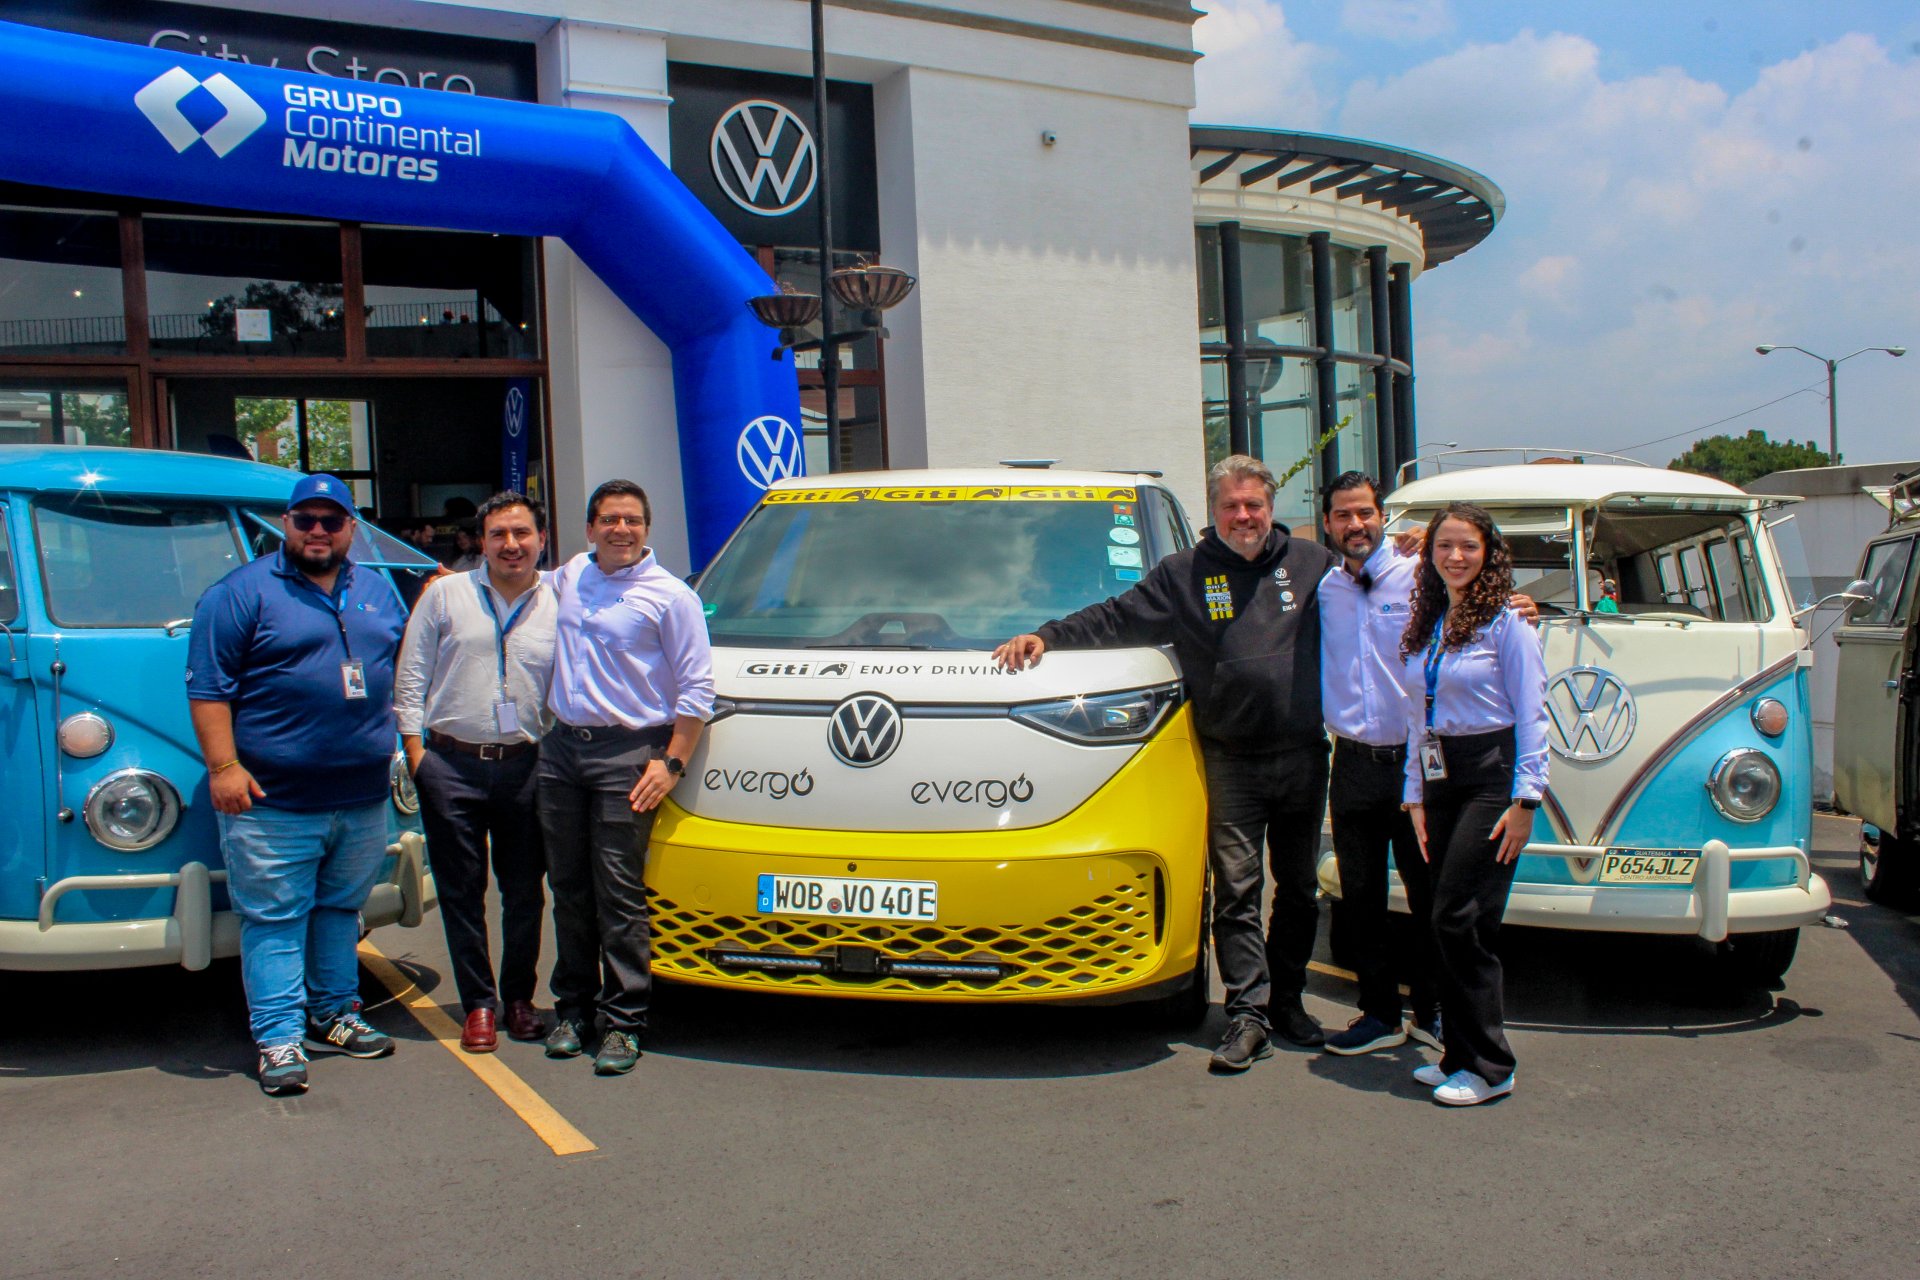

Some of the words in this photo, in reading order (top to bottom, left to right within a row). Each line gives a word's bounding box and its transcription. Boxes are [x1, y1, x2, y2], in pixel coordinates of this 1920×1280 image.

[283, 84, 402, 118] GRUPO
[285, 107, 480, 156] Continental
[283, 138, 438, 182] Motores
[767, 491, 828, 502] Giti
[883, 489, 957, 499] Giti
[1019, 489, 1094, 499] Giti
[746, 663, 810, 675] Giti
[860, 665, 923, 675] ENJOY
[931, 665, 1018, 676] DRIVING
[704, 766, 815, 799] evergo
[911, 772, 1034, 808] evergo
[1606, 857, 1694, 876] P654JLZ
[776, 880, 823, 911] WOB
[843, 884, 875, 912] VO
